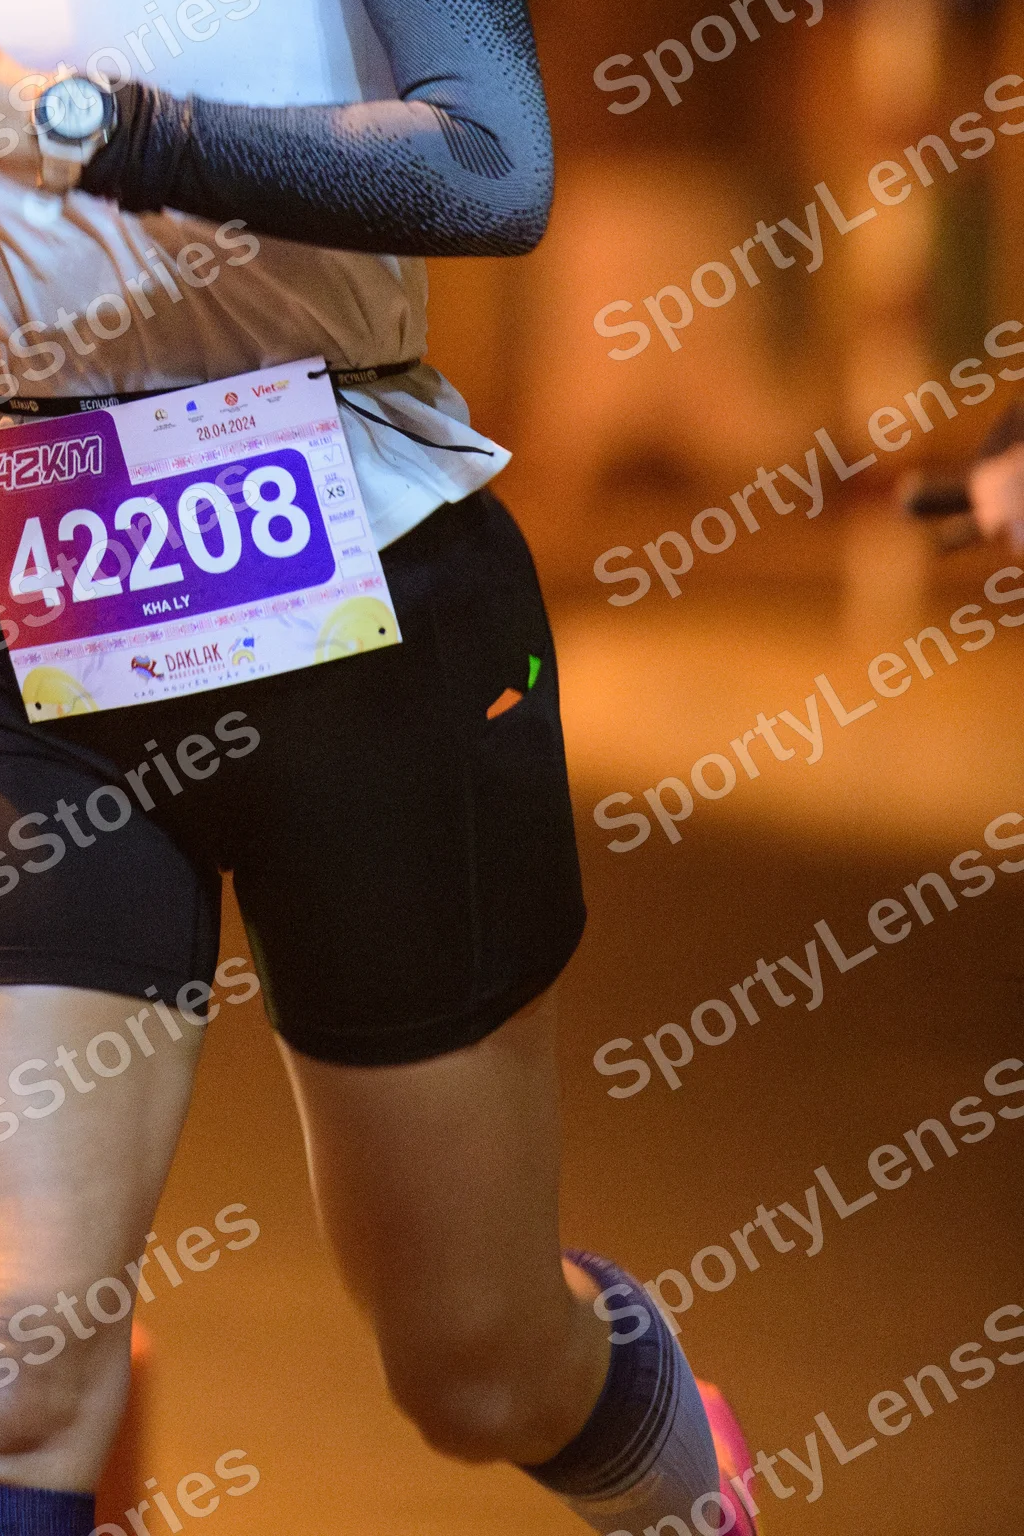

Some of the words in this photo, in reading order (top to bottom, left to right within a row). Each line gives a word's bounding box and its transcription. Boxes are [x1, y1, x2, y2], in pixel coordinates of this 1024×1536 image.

[197, 415, 256, 441] 28.04.2024
[326, 485, 345, 499] XS
[9, 465, 311, 608] 42208
[142, 600, 171, 617] KHA
[173, 594, 190, 610] LY
[165, 643, 223, 672] DAKLAK
